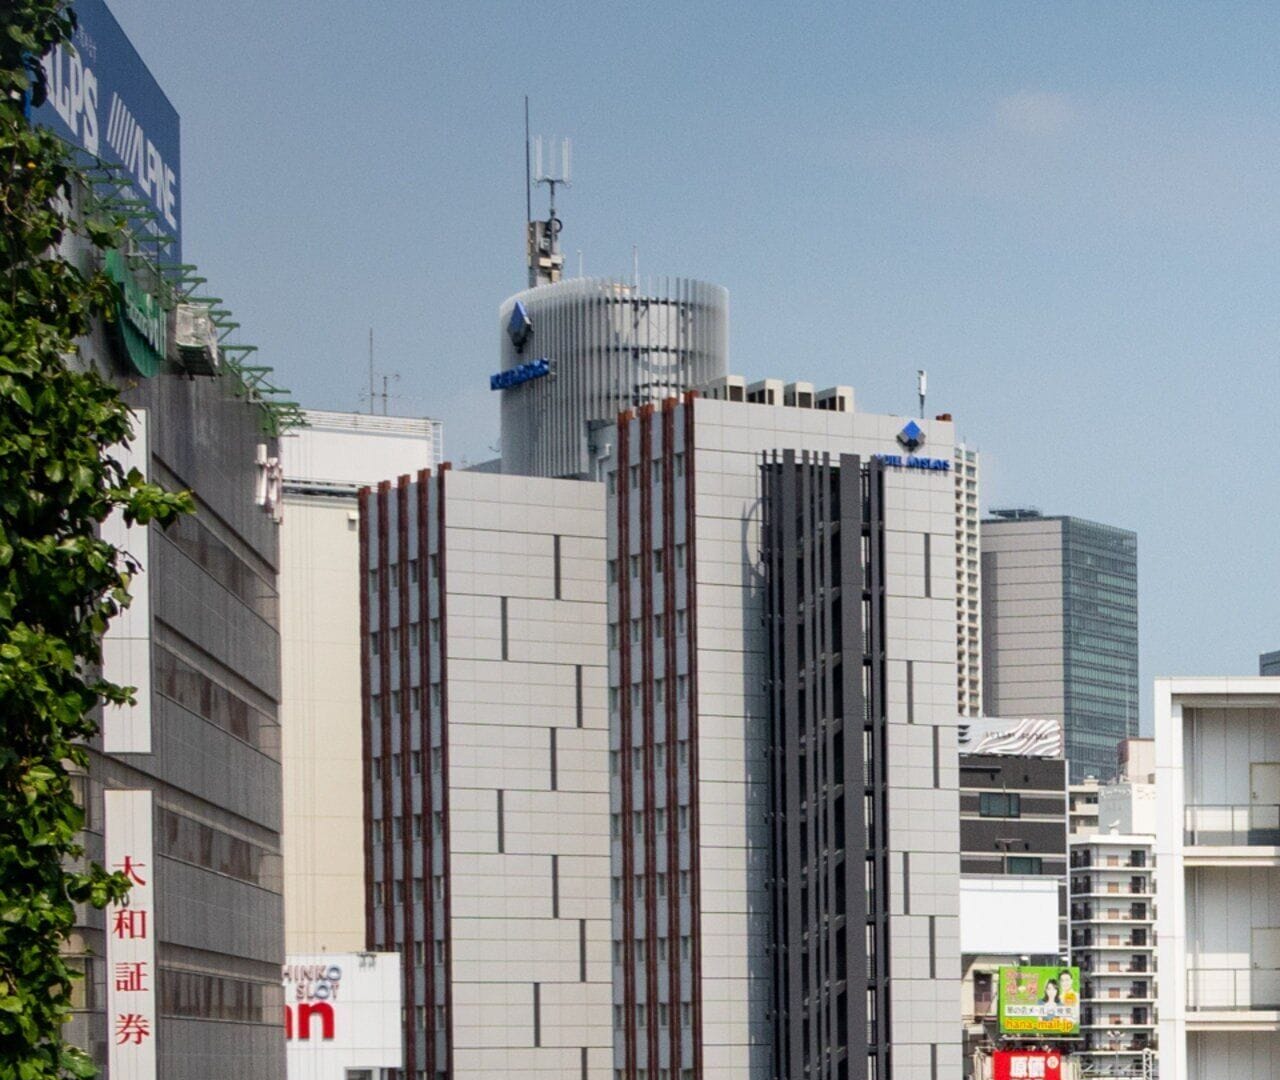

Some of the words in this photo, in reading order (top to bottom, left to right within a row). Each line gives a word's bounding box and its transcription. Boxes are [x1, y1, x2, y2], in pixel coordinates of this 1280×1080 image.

[112, 856, 150, 1046] 大和証券
[296, 982, 340, 1000] SLOT
